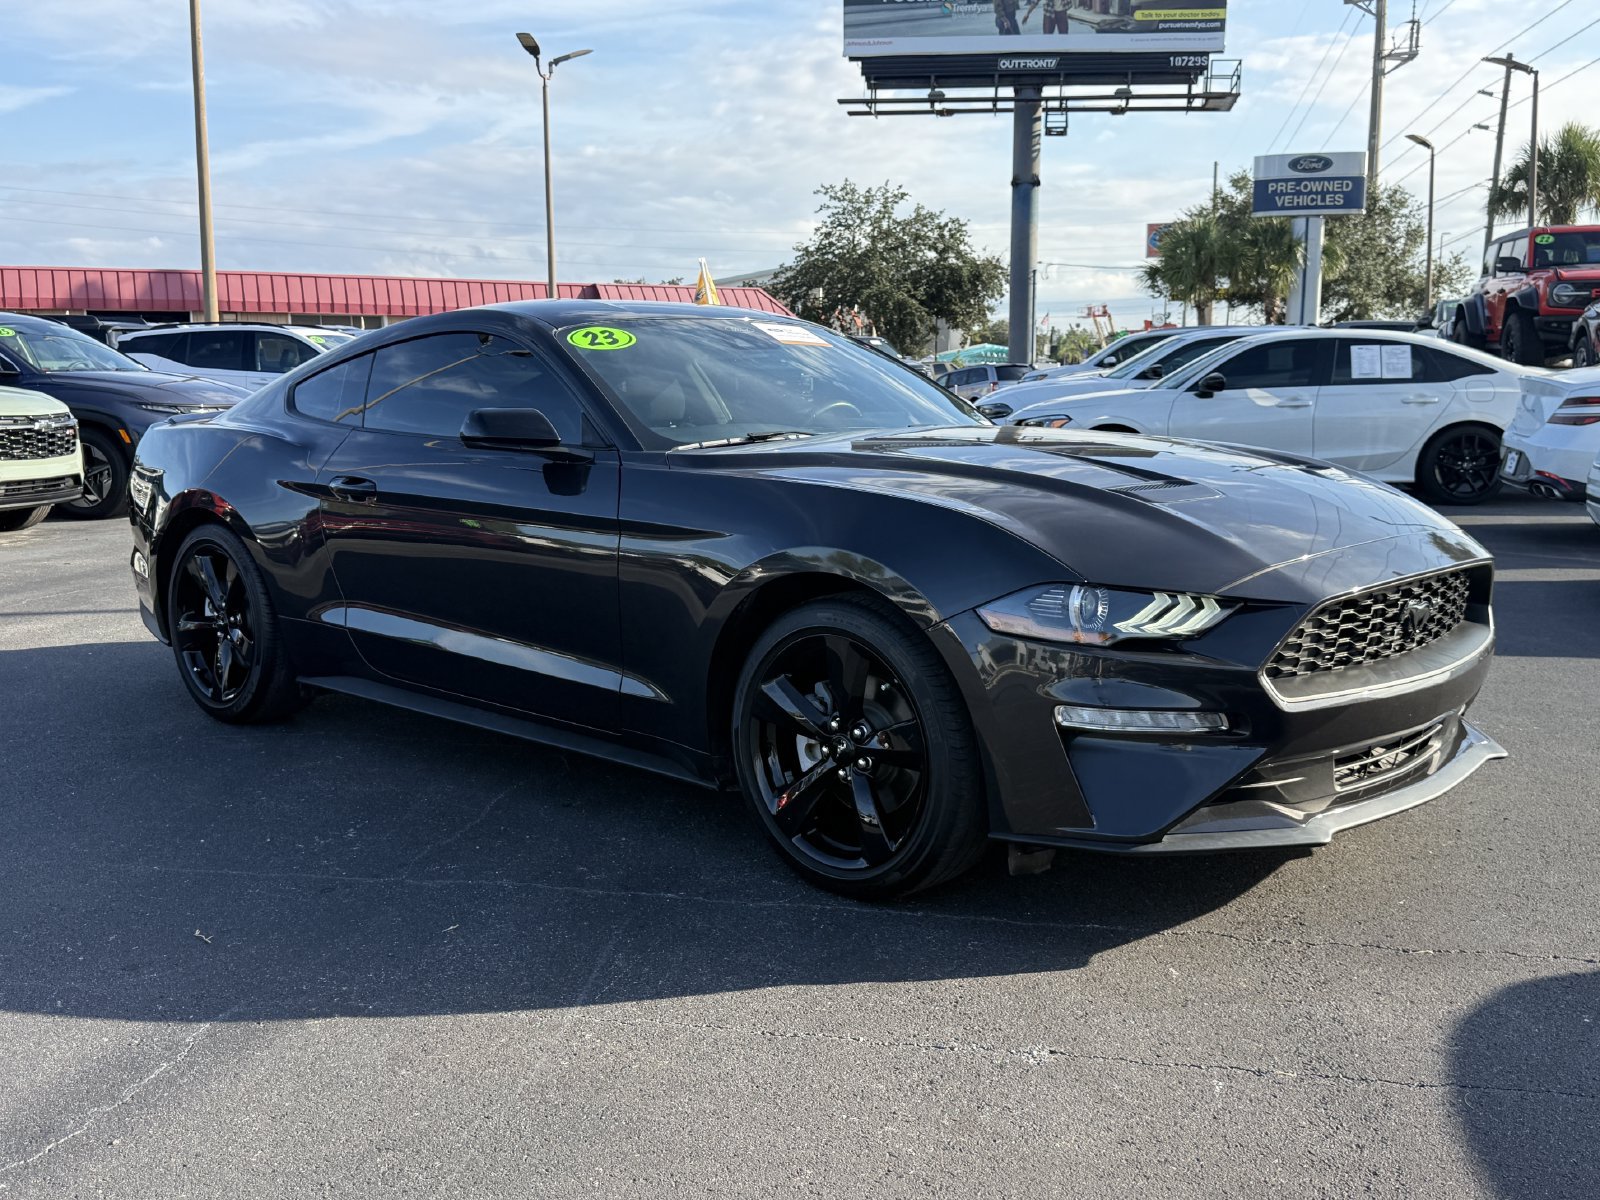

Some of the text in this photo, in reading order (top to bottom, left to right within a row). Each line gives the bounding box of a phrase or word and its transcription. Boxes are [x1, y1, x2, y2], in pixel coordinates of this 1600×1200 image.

[1297, 158, 1325, 170] Ford
[1268, 180, 1353, 194] PRE-OWNED
[1275, 194, 1345, 207] VEHICLES
[582, 330, 620, 346] 23
